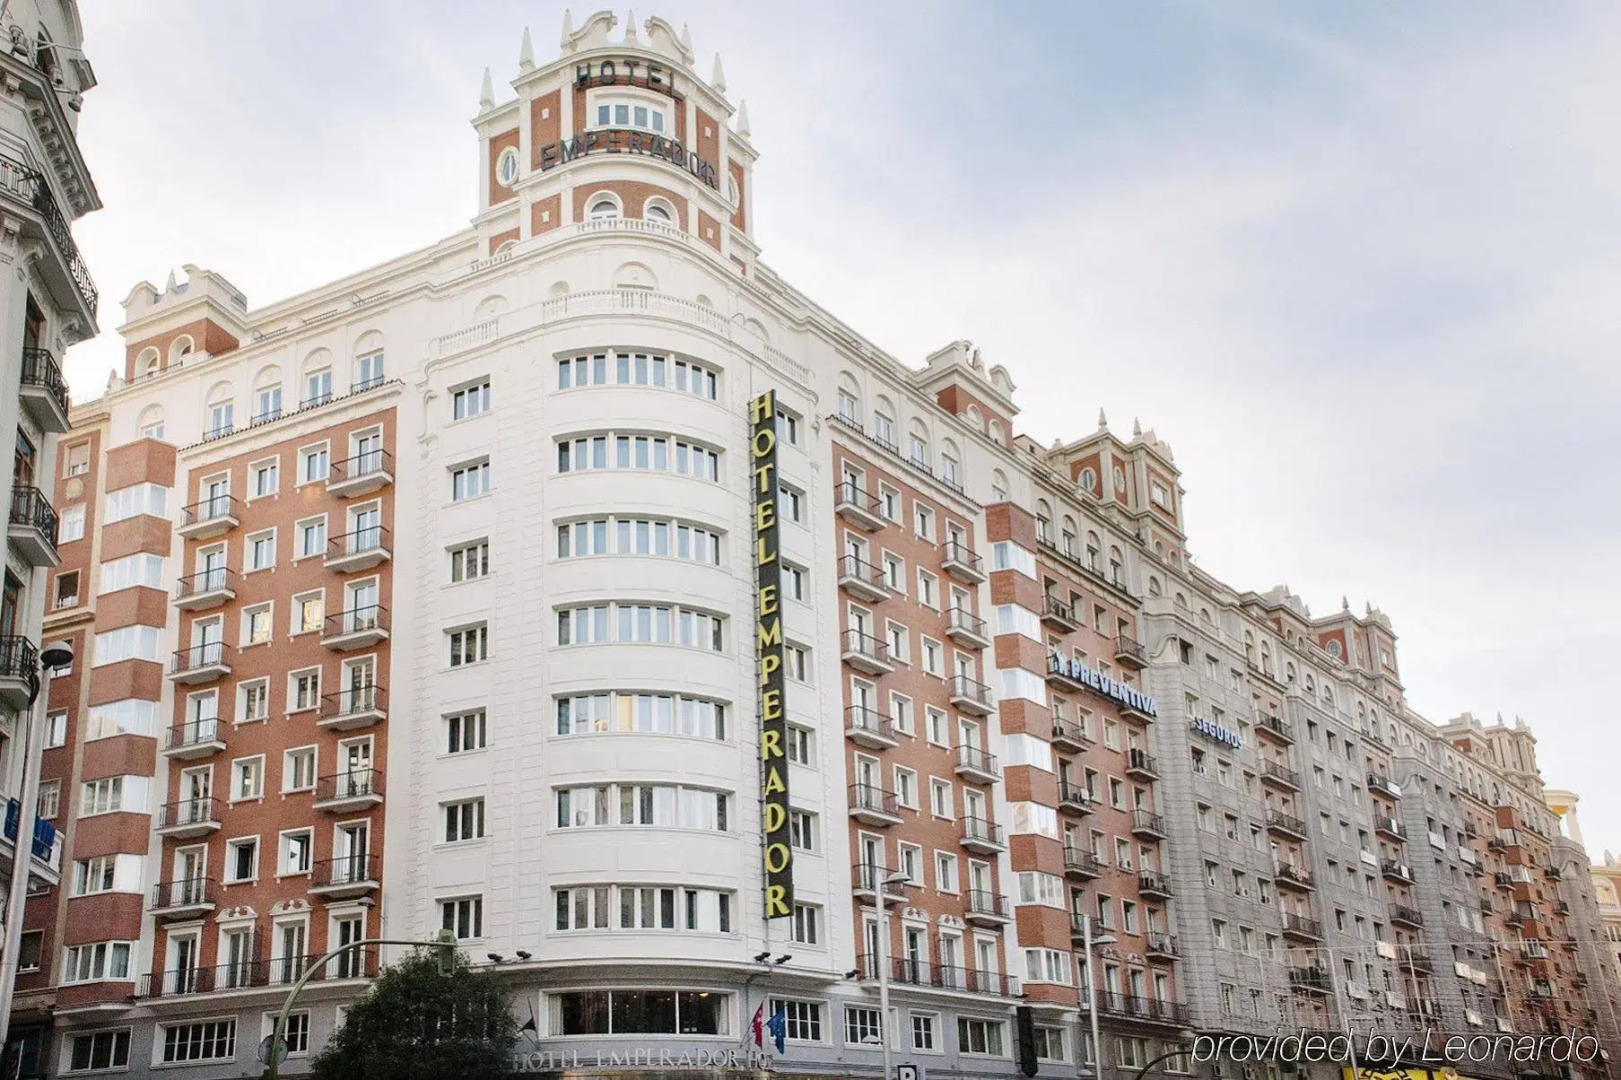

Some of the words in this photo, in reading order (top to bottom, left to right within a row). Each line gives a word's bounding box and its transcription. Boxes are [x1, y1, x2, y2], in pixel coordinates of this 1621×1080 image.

[576, 60, 686, 101] HOTEL
[541, 129, 718, 190] EMPERADOR
[753, 391, 777, 565] HOTEL
[1070, 658, 1158, 718] PREVENTIVA
[758, 584, 791, 917] EMPERADOR
[1195, 714, 1243, 750] SEGUROS
[512, 1049, 584, 1073] HOTEL
[597, 1046, 740, 1069] EMPERADOR
